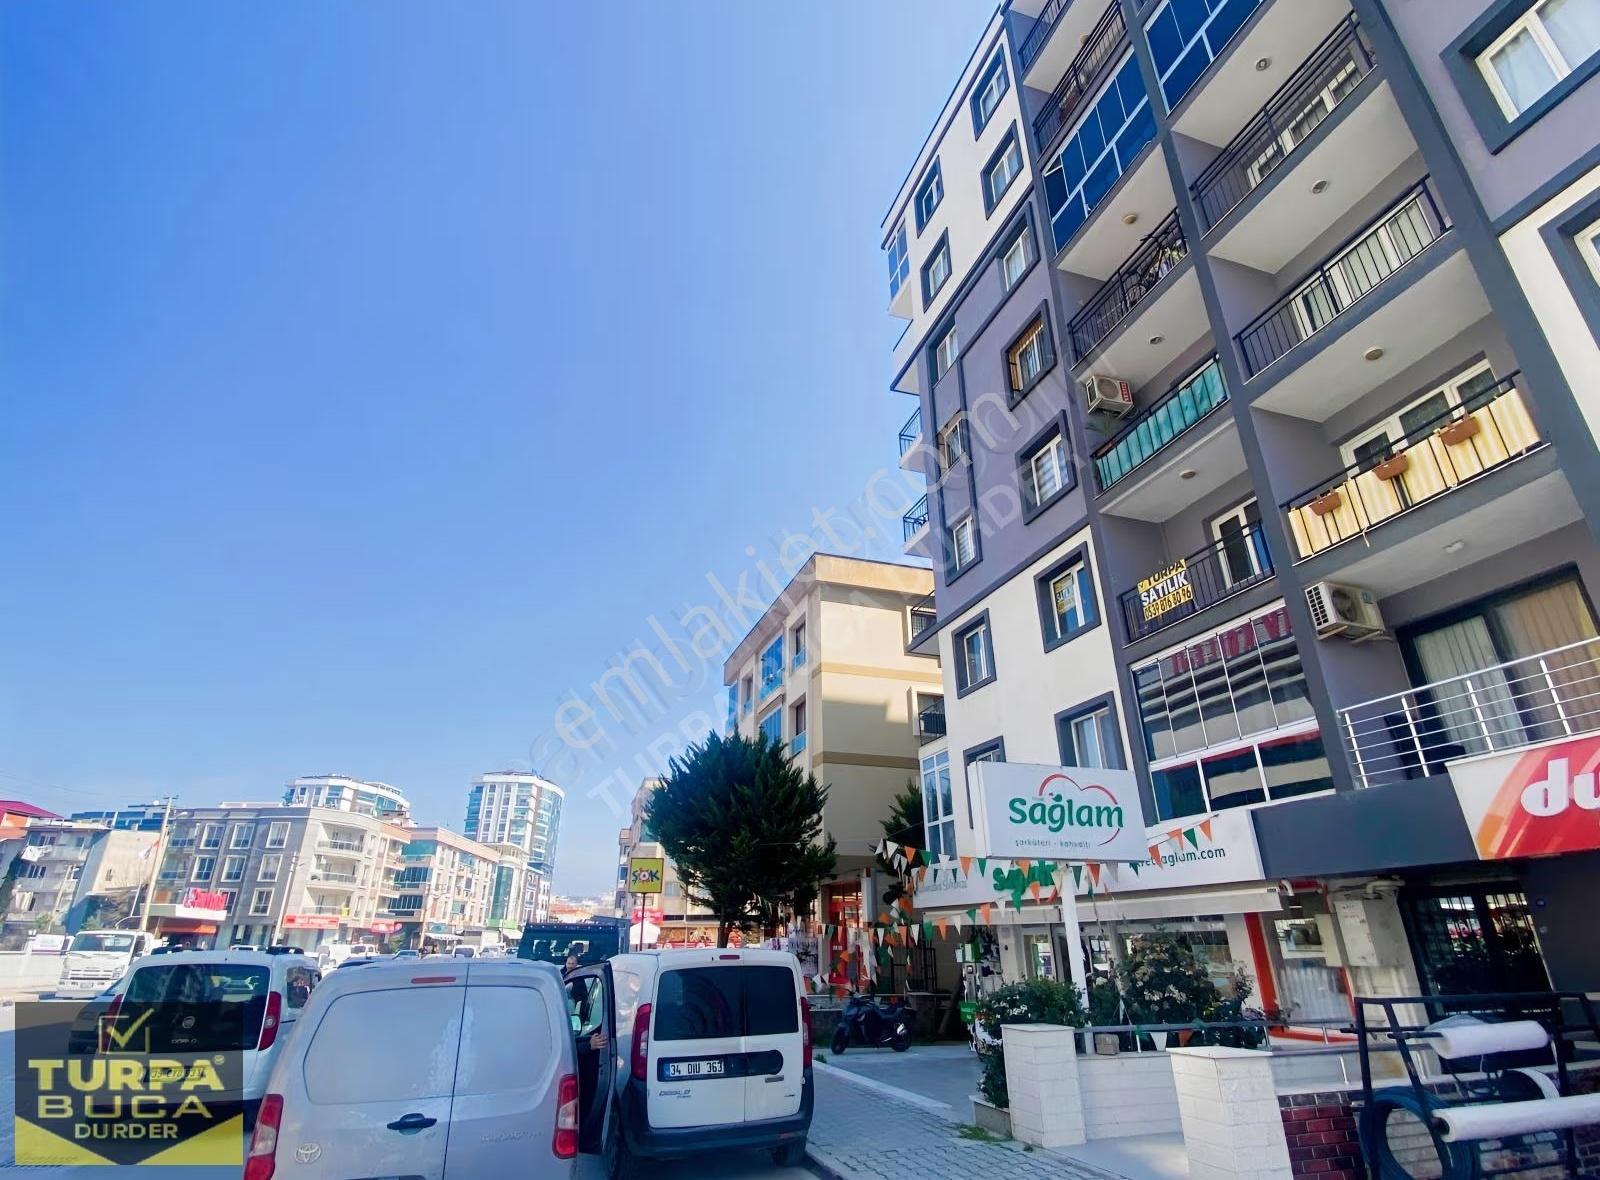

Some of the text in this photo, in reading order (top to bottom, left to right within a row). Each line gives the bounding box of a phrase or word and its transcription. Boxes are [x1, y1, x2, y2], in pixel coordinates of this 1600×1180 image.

[1147, 560, 1185, 586] TURPA
[1141, 571, 1188, 607] SATILIK
[1008, 793, 1124, 833] Sağlam
[631, 868, 660, 885] ŞOK
[670, 1064, 681, 1076] 34
